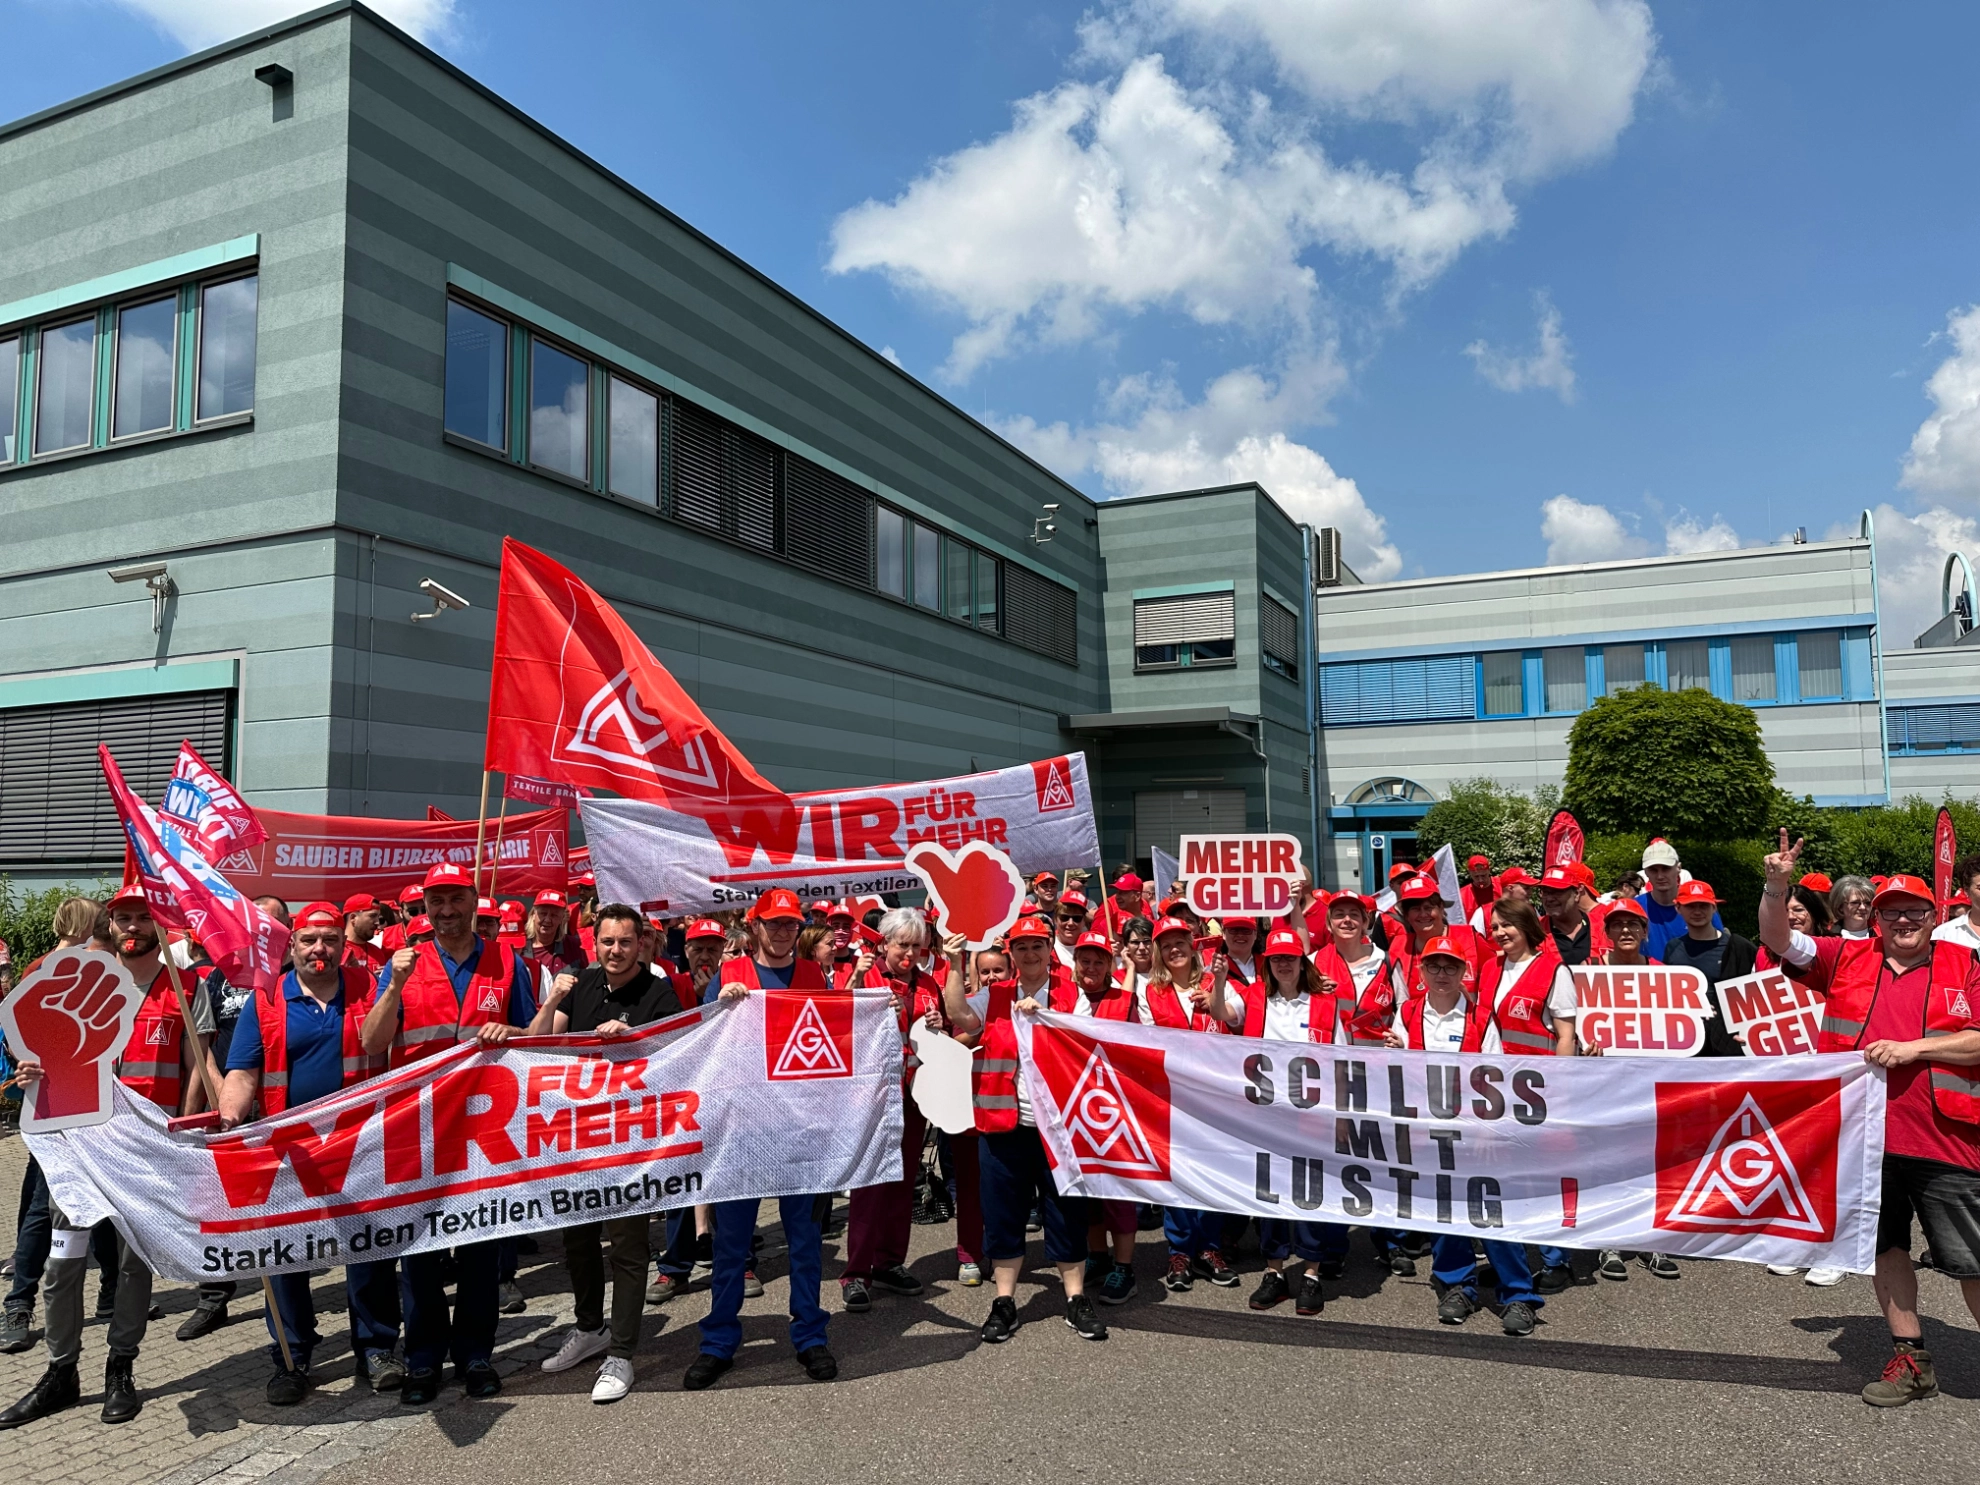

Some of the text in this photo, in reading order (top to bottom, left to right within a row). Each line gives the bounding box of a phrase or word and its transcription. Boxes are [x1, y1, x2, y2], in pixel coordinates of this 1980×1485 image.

[513, 781, 575, 798] TEXTILE BRA
[903, 788, 977, 824] FÜR
[705, 797, 907, 868] WIR
[907, 817, 1008, 849] MEHR
[275, 844, 364, 869] SAUBER
[484, 839, 531, 860] TARIF
[1186, 840, 1296, 873] MEHR
[147, 891, 179, 906] TEX
[712, 886, 765, 904] Stark
[797, 884, 835, 898] den
[840, 876, 918, 894] Textilen
[1193, 877, 1290, 911] GELD
[1574, 972, 1703, 1009] MEHR
[1724, 974, 1826, 1024] MEH
[1582, 1012, 1696, 1050] GELD
[1747, 1011, 1821, 1057] GEL
[527, 1053, 648, 1107] FÜR
[1243, 1053, 1547, 1126] SCHLUSS
[206, 1065, 521, 1208] WIR
[526, 1090, 701, 1158] MEHR
[1335, 1117, 1462, 1171] MIT
[1255, 1152, 1503, 1229] LUSTIG
[201, 1169, 703, 1272] Stark in den Textilen Branchen
